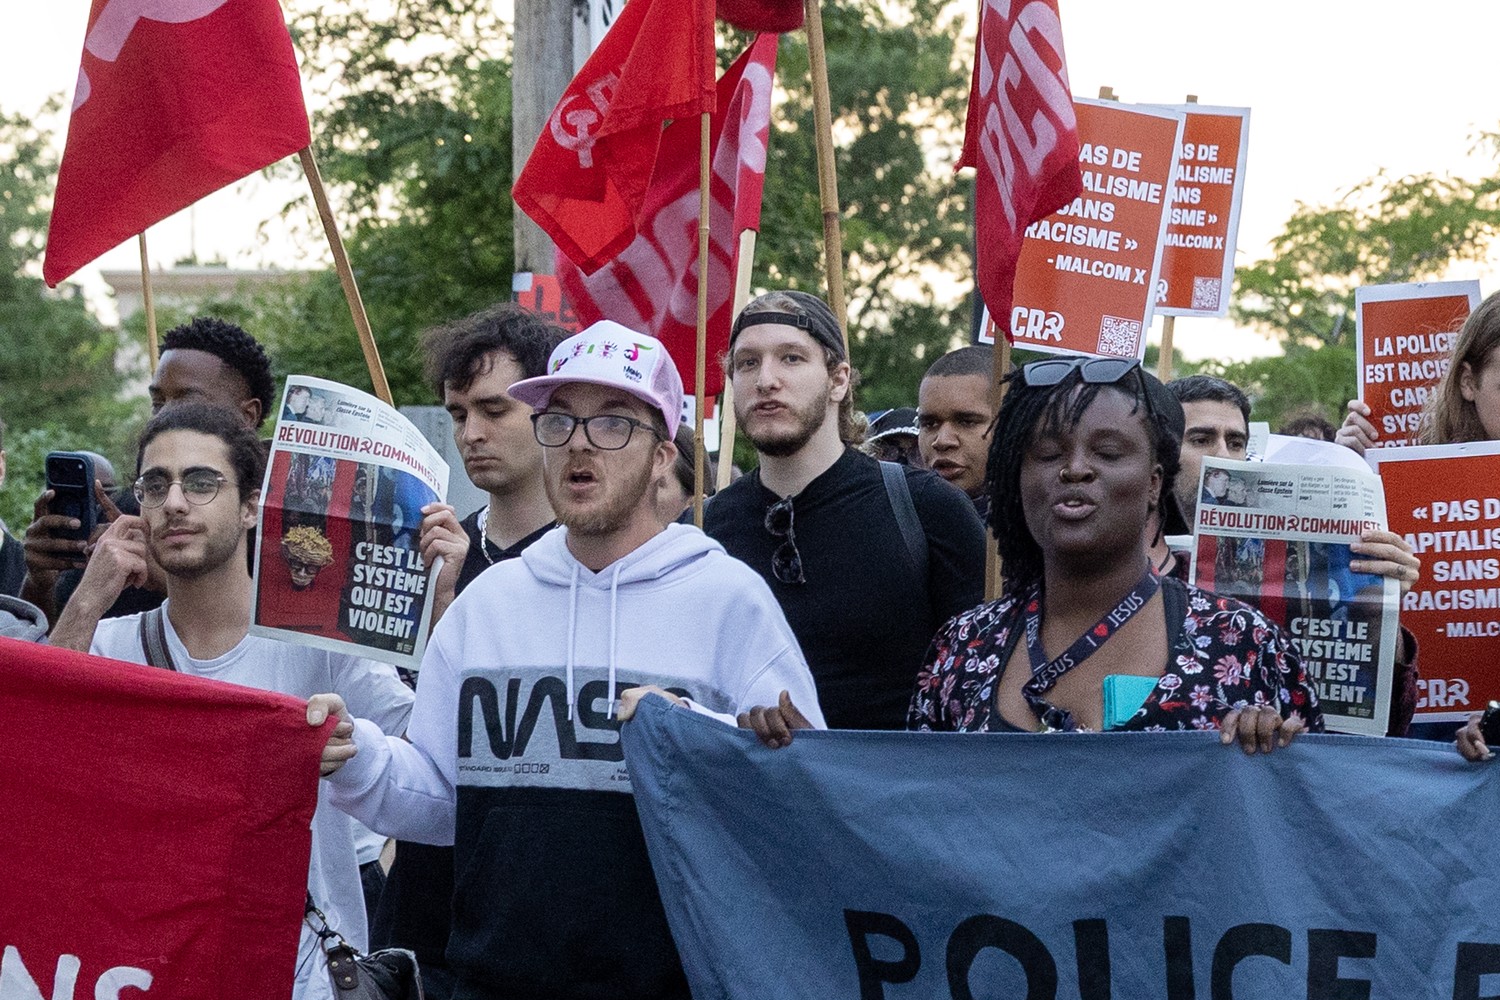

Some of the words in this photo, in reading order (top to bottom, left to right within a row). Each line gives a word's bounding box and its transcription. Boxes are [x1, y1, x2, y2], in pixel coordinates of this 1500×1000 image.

[1079, 143, 1108, 165] AS
[1112, 148, 1142, 172] DE
[1197, 144, 1219, 161] DE
[1024, 221, 1122, 252] RACISME
[1214, 237, 1224, 249] X
[1133, 268, 1147, 285] X
[1374, 337, 1394, 356] LA
[1366, 363, 1394, 383] EST
[278, 425, 361, 453] RÉVOLUTION
[373, 441, 442, 491] COMMUNISTE
[1200, 508, 1286, 532] RÉVOLUTION
[1432, 499, 1480, 522] PAS
[353, 564, 426, 594] SYSTÈME
[1433, 558, 1500, 582] SANS
[350, 586, 382, 608] QUI
[384, 592, 414, 615] EST
[1108, 591, 1144, 628] JESUS
[349, 608, 414, 639] VIOLENT
[1346, 621, 1368, 640] LE
[1326, 661, 1360, 682] EST
